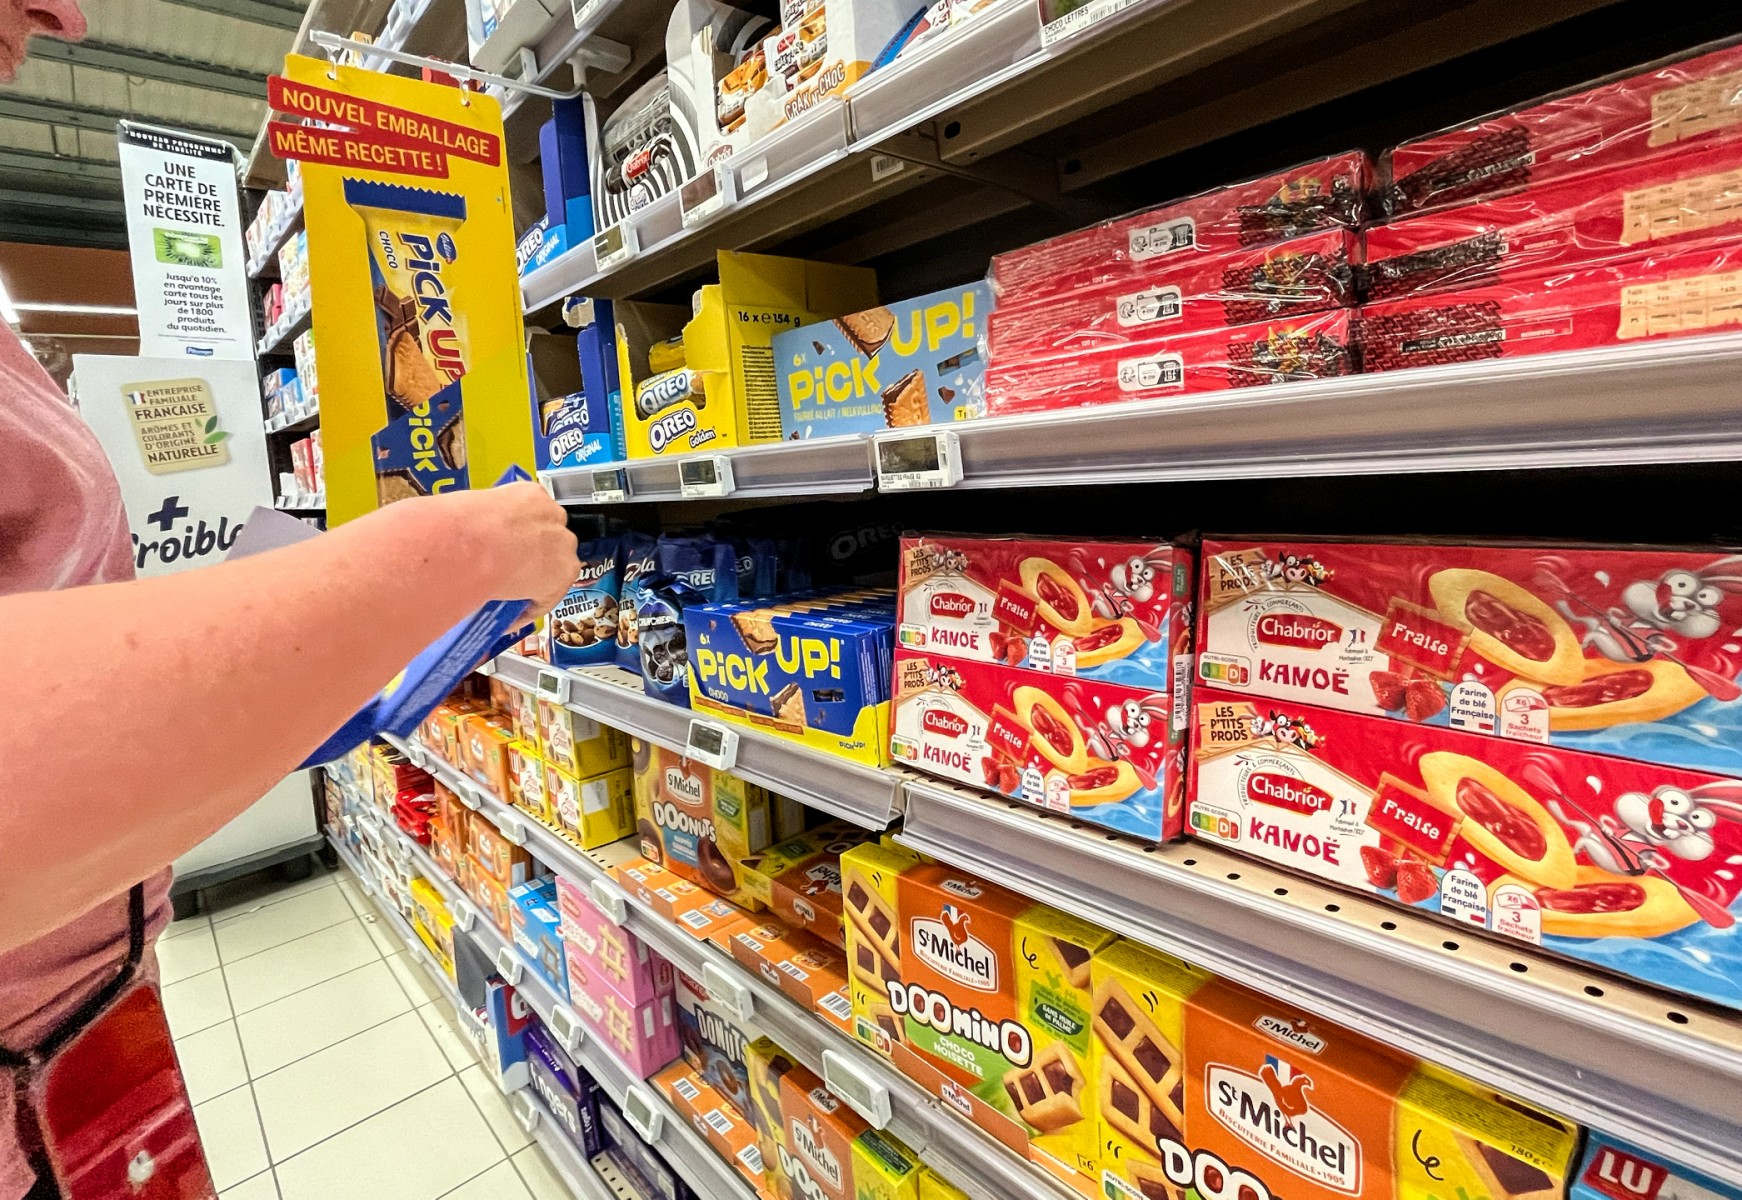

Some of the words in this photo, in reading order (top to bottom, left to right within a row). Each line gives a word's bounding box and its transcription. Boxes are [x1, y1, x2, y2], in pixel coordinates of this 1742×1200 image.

[1065, 6, 1089, 25] LETTRES
[785, 90, 812, 120] CRAK
[819, 63, 845, 97] CHOC
[282, 88, 371, 126] NOUVEL
[377, 112, 490, 157] EMBALLAGE
[276, 130, 342, 158] MÊME
[345, 141, 433, 170] RECETTE
[164, 162, 196, 179] UNE
[145, 174, 193, 193] CARTE
[198, 182, 218, 197] DE
[144, 188, 222, 212] PREMIÈRE
[379, 230, 398, 269] CHOCO
[178, 283, 221, 294] avantage
[202, 276, 217, 285] 10%
[164, 290, 187, 298] carte
[190, 292, 209, 300] tous
[211, 292, 223, 301] les
[164, 298, 188, 307] jours
[206, 301, 224, 309] plus
[177, 307, 189, 315] de
[191, 308, 213, 316] 1800
[178, 316, 215, 325] produits
[738, 311, 750, 323] 16
[753, 315, 759, 323] x
[773, 313, 791, 324] 154
[794, 316, 801, 327] g
[891, 292, 976, 357] UP!
[147, 384, 203, 398] ENTREPRISE
[149, 394, 198, 406] FAMILIALE
[641, 373, 687, 414] OREO
[182, 422, 193, 430] ET
[650, 408, 696, 452] OREO
[142, 430, 195, 442] COLORANTS
[145, 437, 197, 451] D'ORIGINE
[690, 430, 716, 448] Golden
[148, 444, 219, 464] NATURELLE
[550, 428, 583, 464] OREO
[575, 439, 603, 463] ORIGINAL
[132, 517, 244, 569] roibl
[914, 549, 924, 559] LES
[911, 566, 932, 577] PRODS
[555, 599, 600, 620] COOKIES
[932, 596, 973, 613] Chabrior
[1000, 597, 1029, 620] Fraise
[932, 626, 979, 651] KANOË
[1261, 618, 1336, 642] Chabrior
[1392, 623, 1449, 656] Fraise
[775, 634, 841, 680] UP!
[1063, 658, 1067, 666] 3
[904, 670, 922, 679] P'TITS
[907, 662, 918, 671] LES
[1230, 669, 1239, 679] D
[904, 679, 925, 689] PRODS
[1259, 659, 1350, 696] KANOË
[709, 687, 729, 702] CHOCO
[1460, 688, 1488, 699] Farine
[1216, 707, 1234, 718] LES
[1473, 699, 1487, 709] blé
[926, 712, 965, 733] Chabrior
[1451, 707, 1494, 720] Française
[1520, 714, 1530, 725] 3
[1211, 718, 1244, 729] P'TITS
[1508, 723, 1542, 734] Sachets
[994, 723, 1023, 749] Fraise
[1211, 730, 1248, 741] PRODS
[924, 742, 972, 773] KANOË
[674, 776, 701, 798] Michel
[1252, 776, 1326, 809] Chabrior
[1056, 793, 1061, 801] 3
[653, 802, 717, 843] DOONUTS
[1382, 800, 1441, 840] Fraise
[1250, 817, 1341, 867] KANOË
[950, 883, 980, 898] Michel
[1451, 875, 1479, 890] Farine
[1451, 886, 1462, 896] de
[1464, 889, 1478, 900] blé
[1442, 893, 1486, 913] Française
[1500, 918, 1533, 935] Sachets
[1512, 912, 1521, 923] 3
[918, 928, 930, 948] St
[932, 934, 990, 979] Michel
[1270, 1023, 1320, 1050] Michel
[940, 1037, 976, 1062] CHOCO
[934, 1042, 984, 1077] NOISETTE
[816, 1093, 836, 1111] Michel
[1219, 1081, 1239, 1107] St
[1240, 1091, 1345, 1175] Michel
[1219, 1109, 1268, 1150] BISCUITERIE
[1270, 1144, 1316, 1175] FAMILIALE
[1322, 1169, 1345, 1185] 1905
[803, 1133, 839, 1183] Michel
[1600, 1152, 1652, 1194] LU
